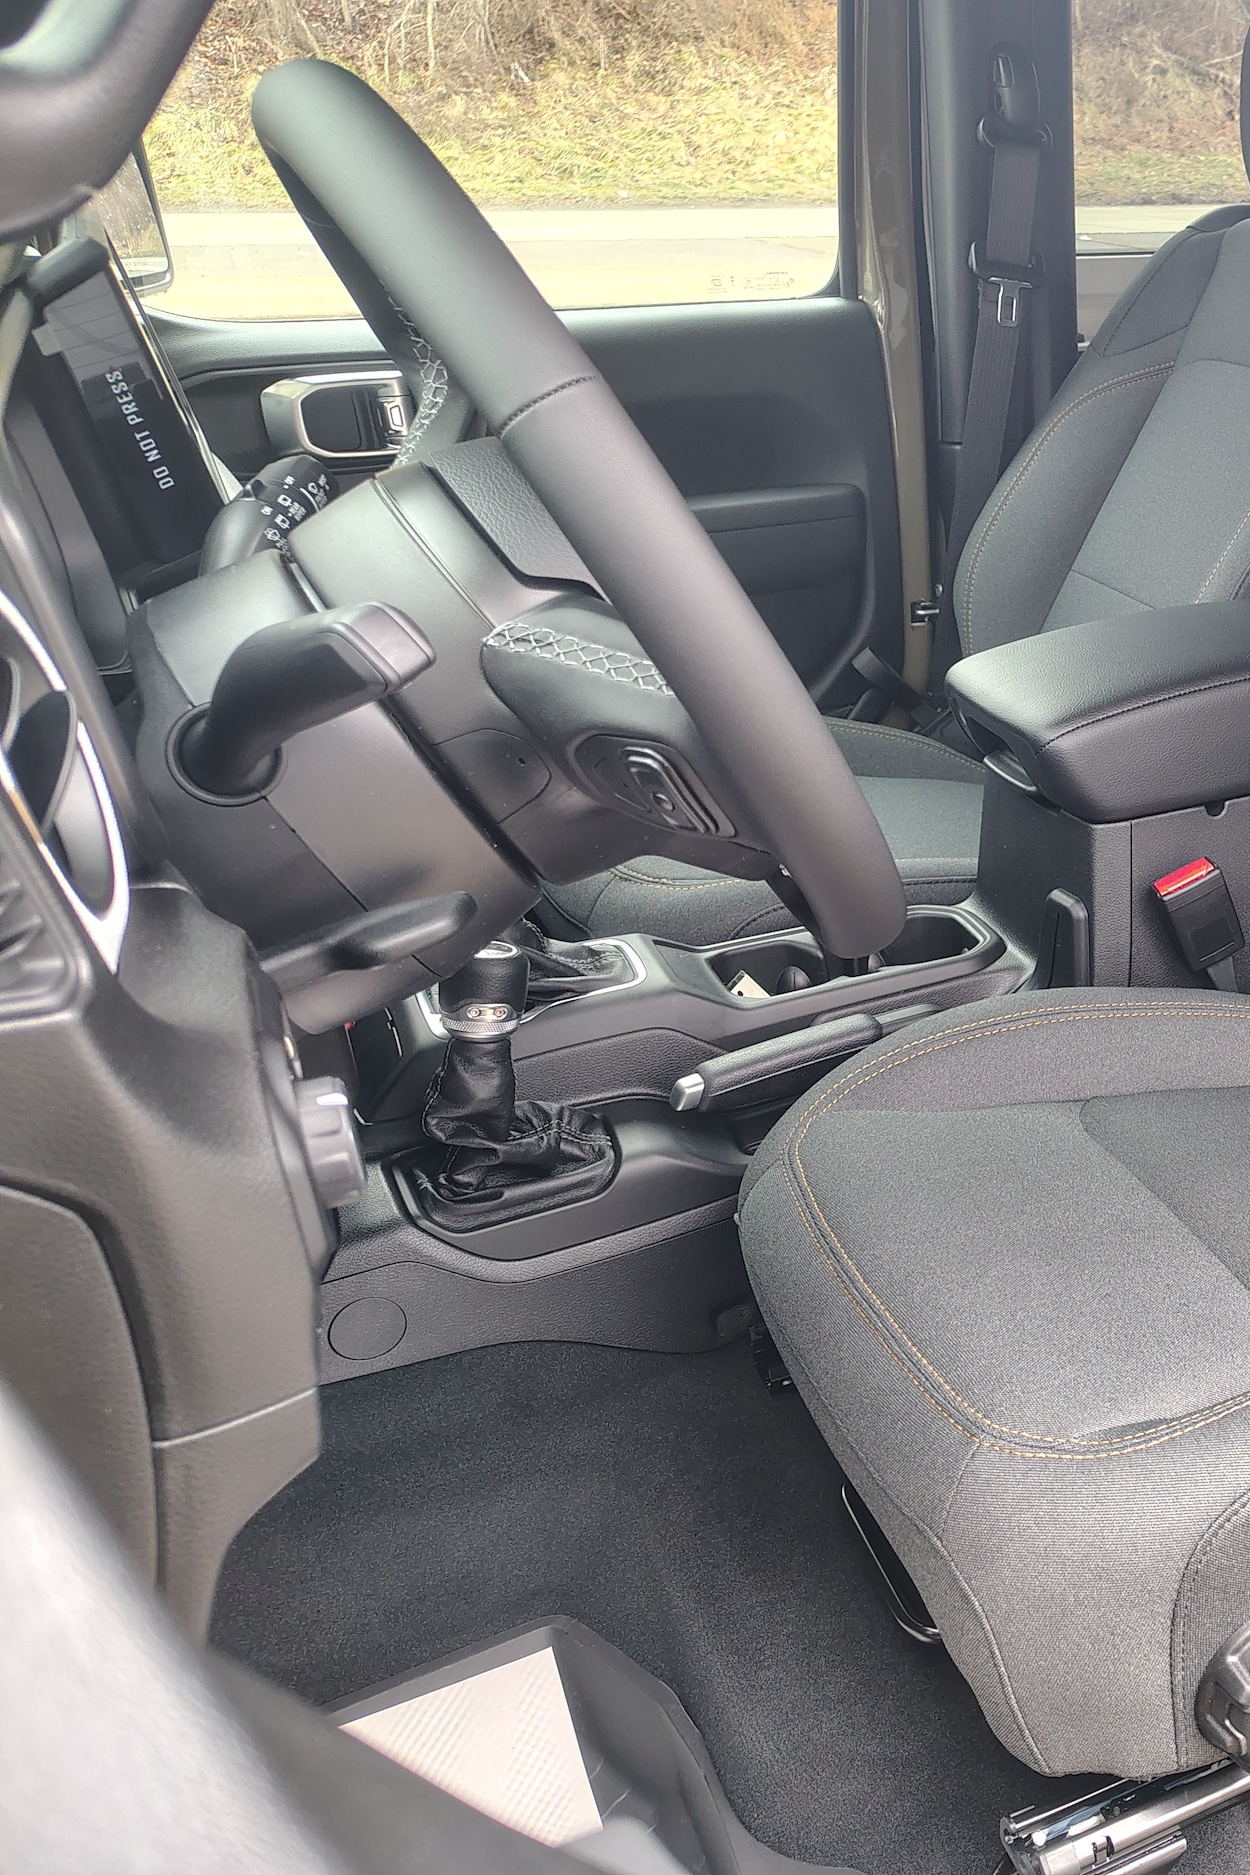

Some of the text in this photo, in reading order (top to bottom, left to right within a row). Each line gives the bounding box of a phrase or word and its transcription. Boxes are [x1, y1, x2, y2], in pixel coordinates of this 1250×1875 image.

[105, 370, 175, 490] DO NOT PRESS
